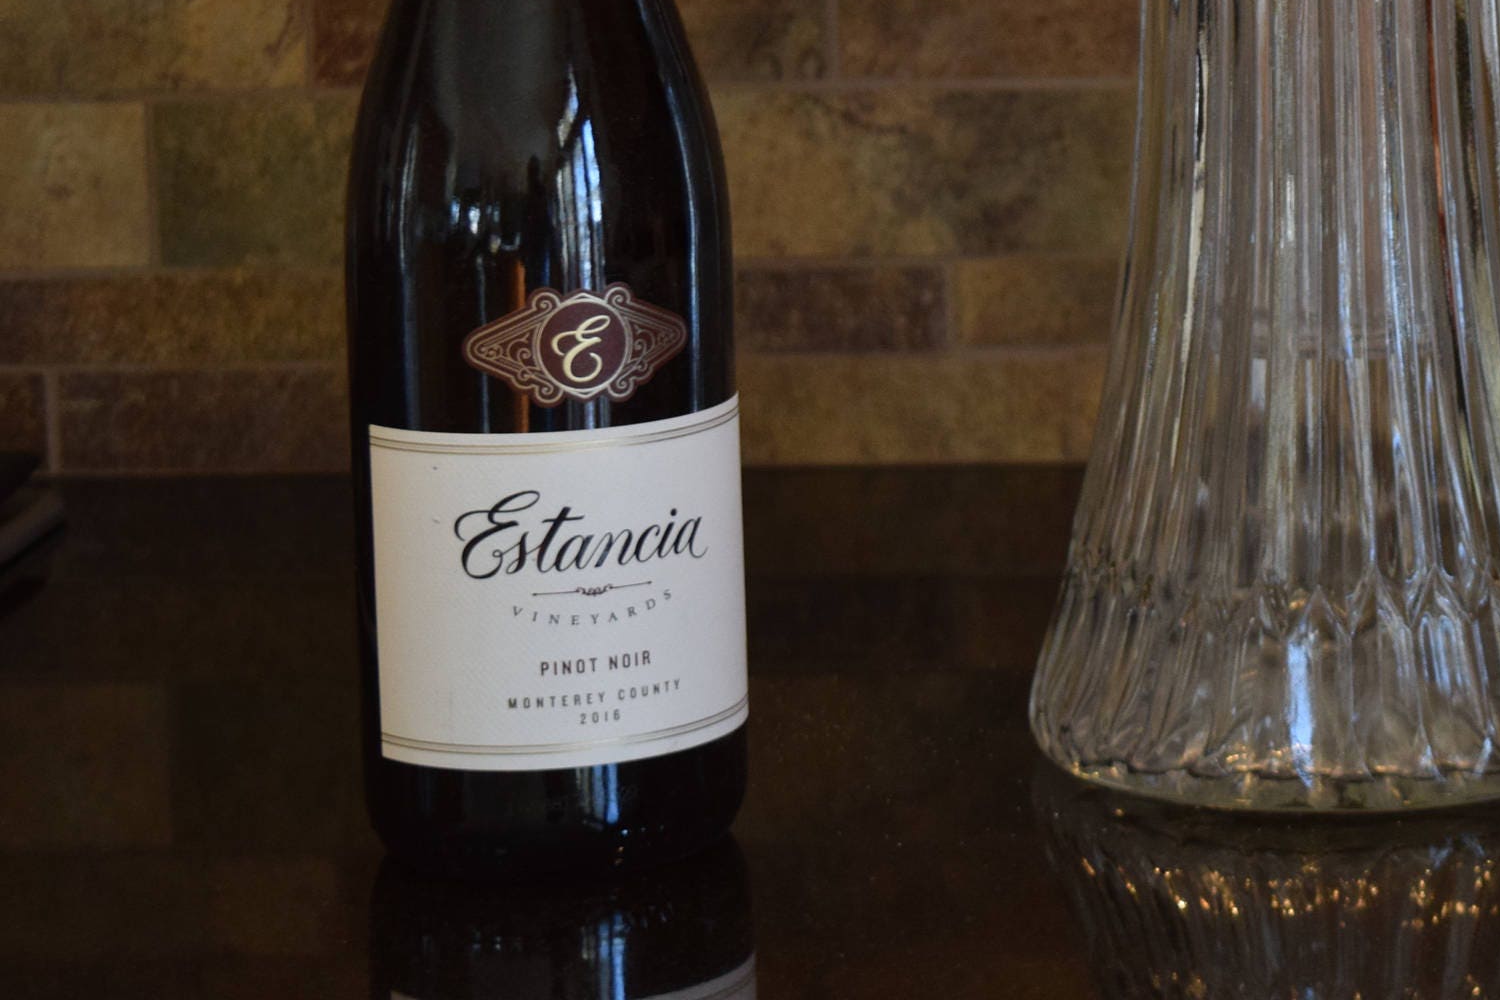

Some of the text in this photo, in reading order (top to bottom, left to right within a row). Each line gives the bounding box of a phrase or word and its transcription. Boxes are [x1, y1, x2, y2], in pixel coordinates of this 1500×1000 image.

[551, 315, 611, 383] E
[453, 490, 708, 580] Estancia
[512, 587, 672, 626] VINEYARDS
[540, 650, 651, 677] PINOT NOIR
[507, 678, 681, 711] MONTEREY COUNTY
[579, 708, 621, 725] 2016
